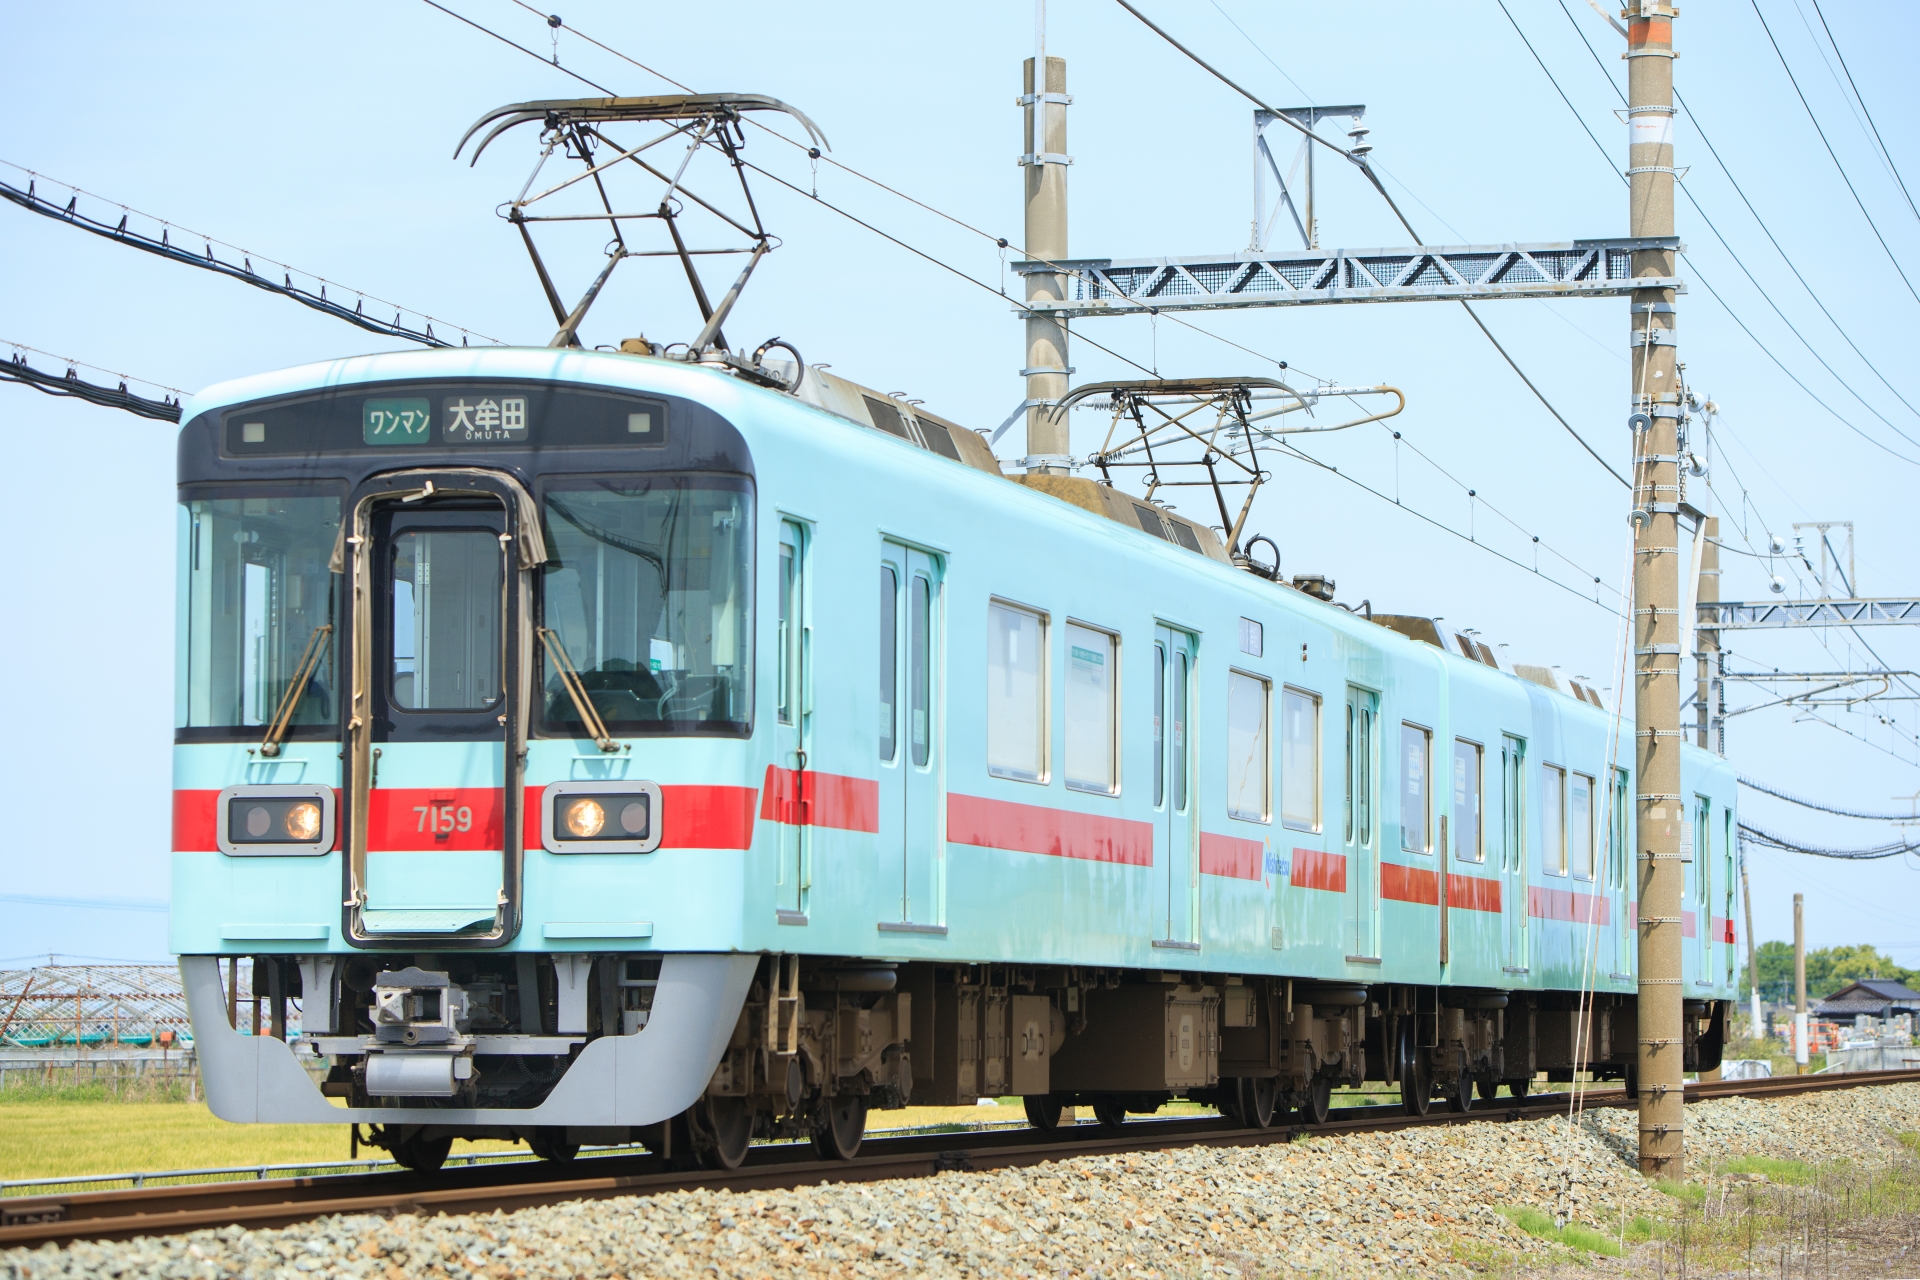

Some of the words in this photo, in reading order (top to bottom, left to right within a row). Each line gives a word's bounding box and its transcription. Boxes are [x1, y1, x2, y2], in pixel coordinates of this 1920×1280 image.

[371, 410, 430, 434] ワンマン
[449, 398, 525, 432] 大牟田
[413, 806, 472, 833] 7159
